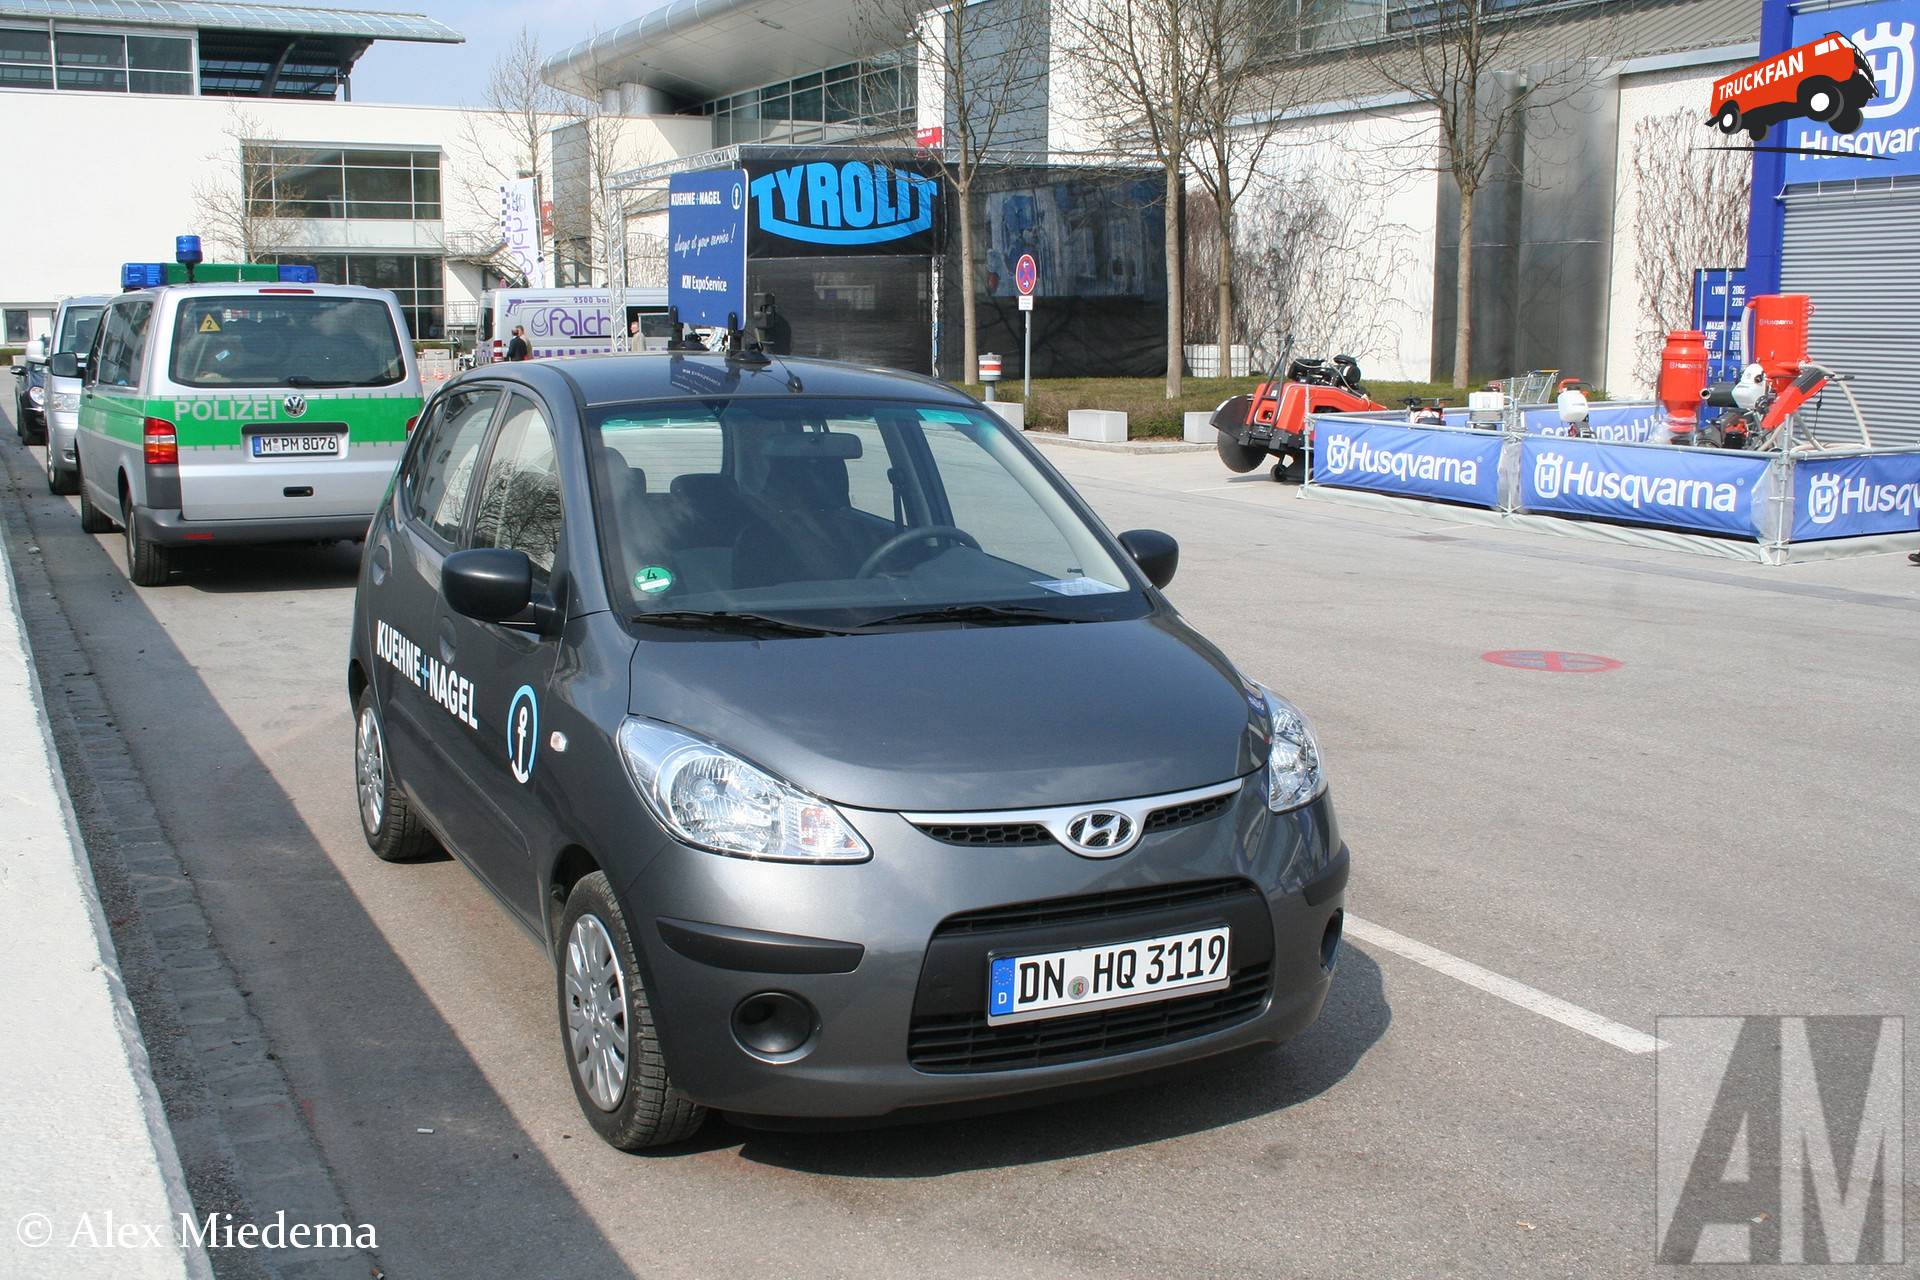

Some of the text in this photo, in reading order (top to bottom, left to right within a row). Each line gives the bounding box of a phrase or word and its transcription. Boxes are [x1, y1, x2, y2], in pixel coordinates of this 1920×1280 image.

[751, 161, 937, 245] TYROLIT
[682, 275, 727, 294] KN ExpoService
[174, 400, 277, 421] POLIZEI
[263, 437, 335, 451] M PM 8076
[1349, 441, 1477, 486] Husqvarna
[1562, 461, 1737, 512] Husqvarna
[647, 568, 658, 580] 4
[376, 619, 478, 730] KUEHNE+NAGEL
[1018, 958, 1065, 1004] DN
[1093, 949, 1137, 994] HQ
[1146, 935, 1226, 985] 3119
